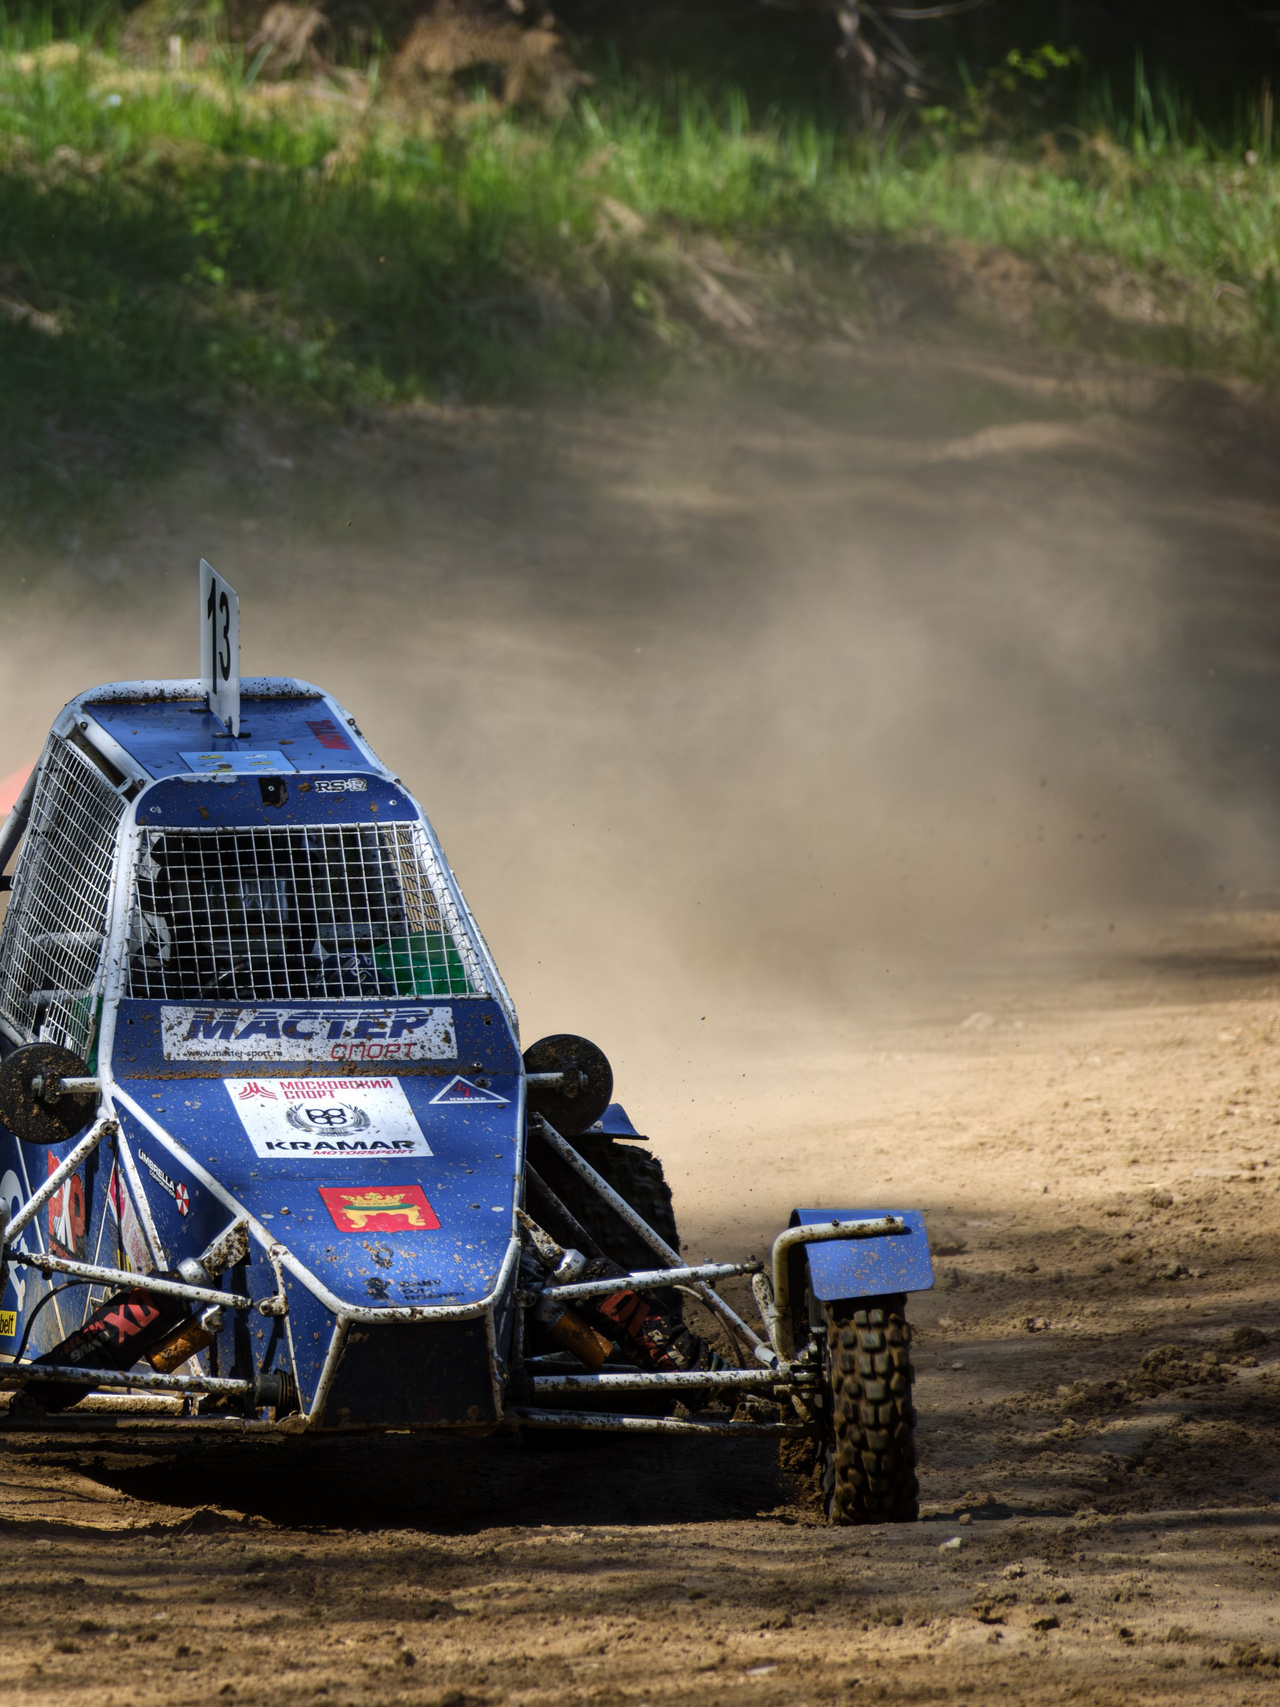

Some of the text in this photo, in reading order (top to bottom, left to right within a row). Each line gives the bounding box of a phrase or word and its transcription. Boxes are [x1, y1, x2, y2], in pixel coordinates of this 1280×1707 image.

[207, 577, 231, 696] 13
[185, 1010, 430, 1040] МАСТЕР
[330, 1043, 418, 1060] СПОРТ
[279, 1078, 394, 1091] МОСКОВСКИЙ
[283, 1090, 336, 1100] СПОРТ
[265, 1140, 416, 1151] KRAMAR
[138, 1148, 175, 1191] UMBRELLA
